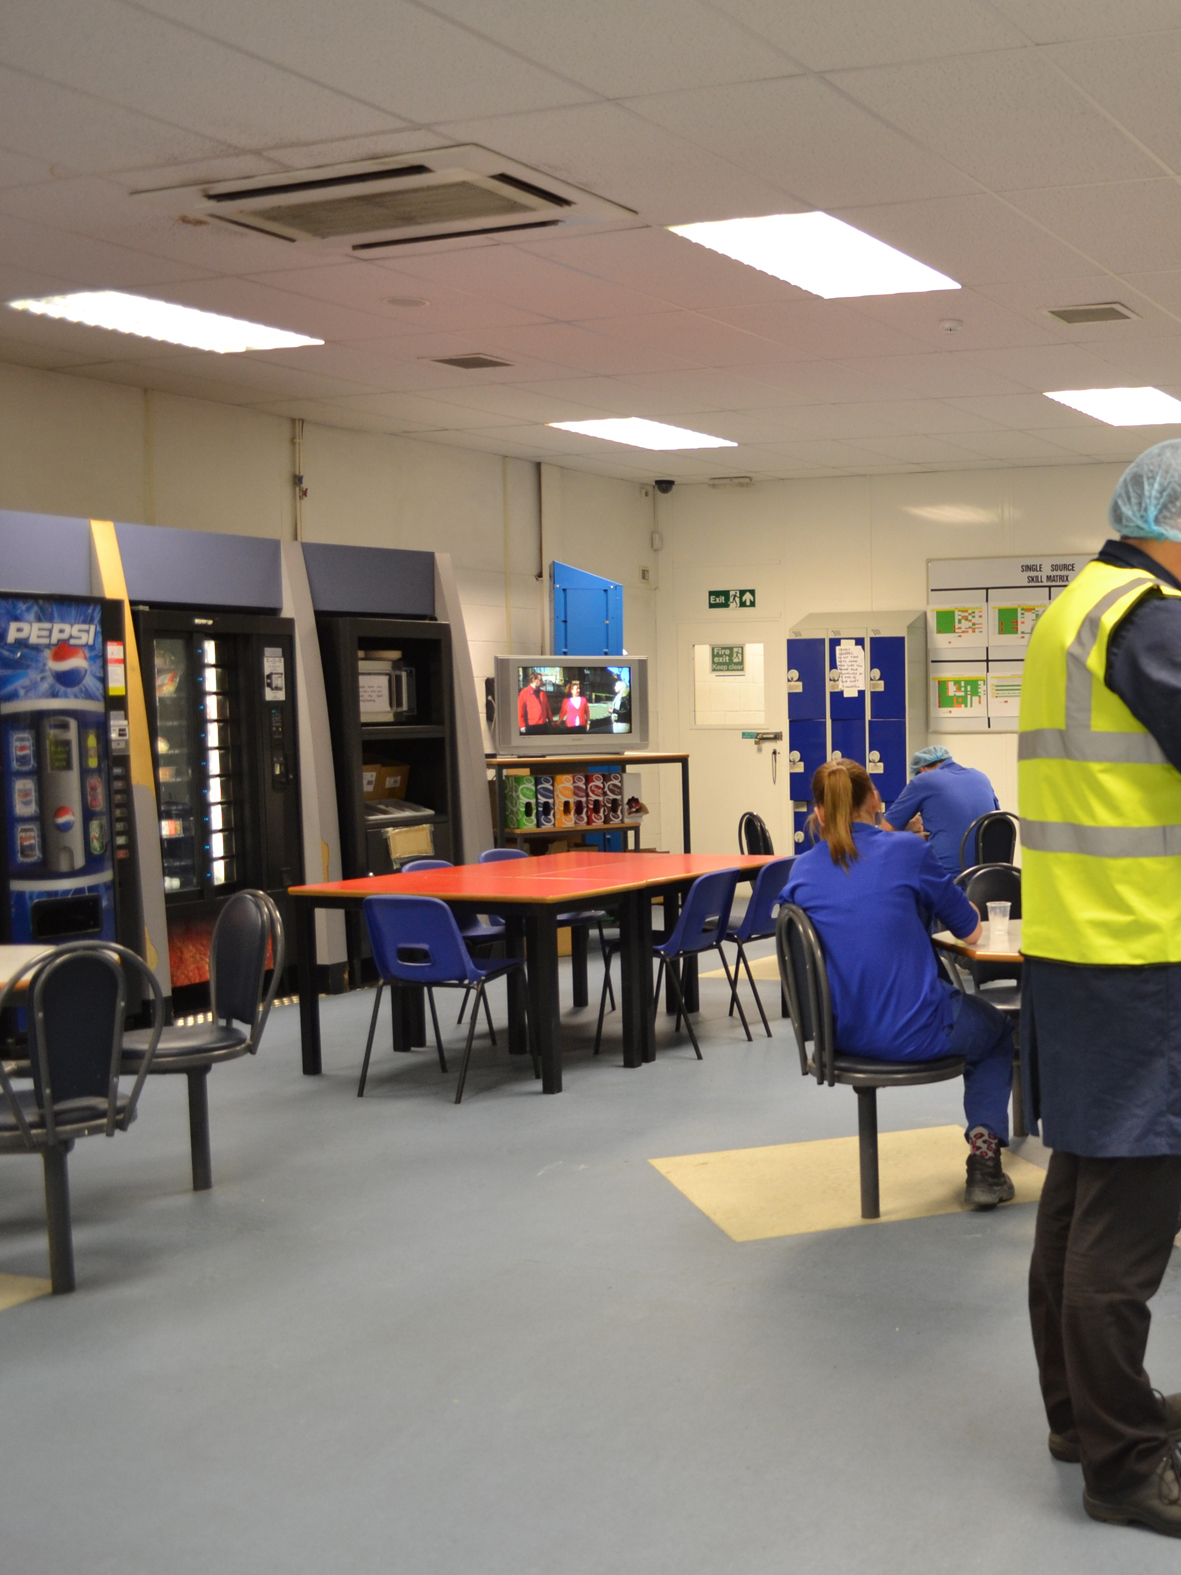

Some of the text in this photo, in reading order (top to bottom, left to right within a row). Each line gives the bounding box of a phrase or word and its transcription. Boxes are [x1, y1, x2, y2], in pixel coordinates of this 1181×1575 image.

[1020, 563, 1076, 573] SINGLE SOURCE
[1026, 574, 1070, 583] SKILL MATRIX
[710, 595, 725, 604] Exit
[6, 621, 96, 646] PEPSI
[713, 647, 730, 655] Fire
[713, 655, 729, 663] exit
